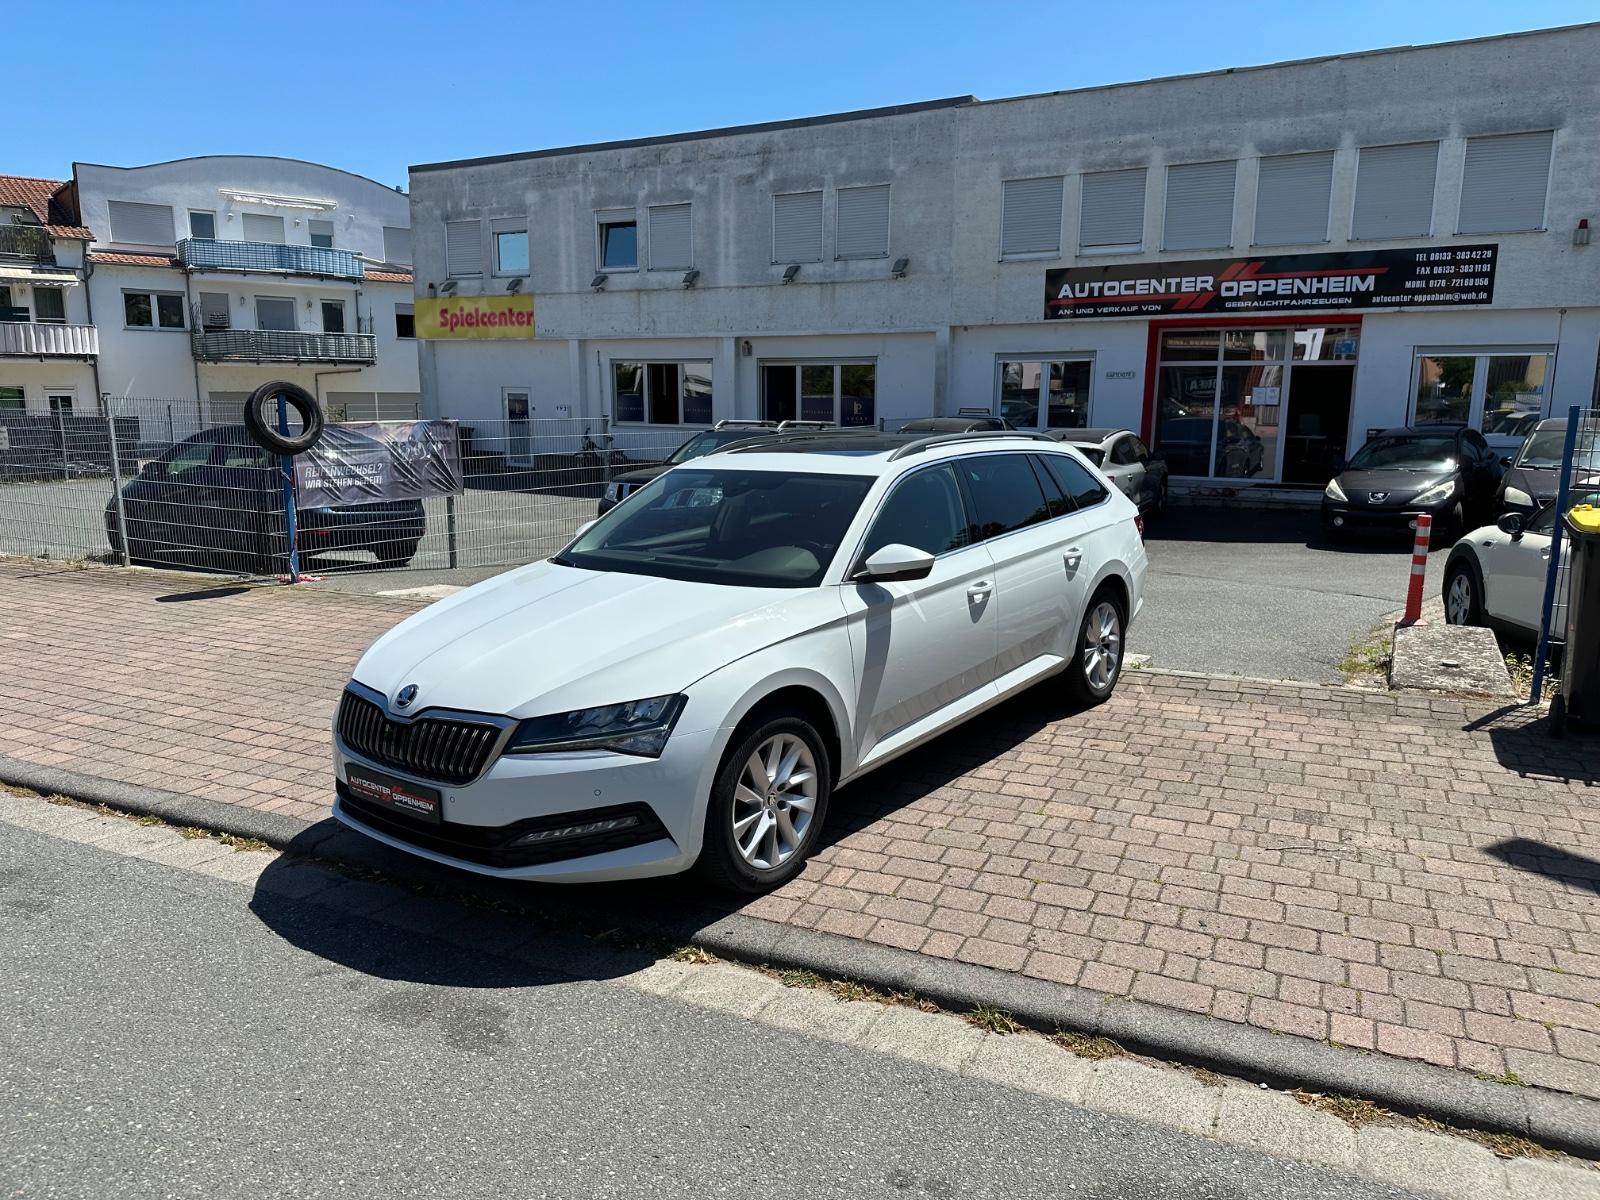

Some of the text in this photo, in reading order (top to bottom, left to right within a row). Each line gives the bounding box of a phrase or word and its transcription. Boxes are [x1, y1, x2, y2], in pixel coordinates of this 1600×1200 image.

[1058, 275, 1375, 298] AUTOCENTER OPPENHEIM
[1225, 297, 1352, 308] GEBRAUCHTFAHRZEUGEN
[439, 306, 534, 332] Spielcenter
[305, 480, 321, 489] WIR
[350, 776, 391, 795] AUTOCENTER
[392, 793, 434, 811] OPPENHEIM
